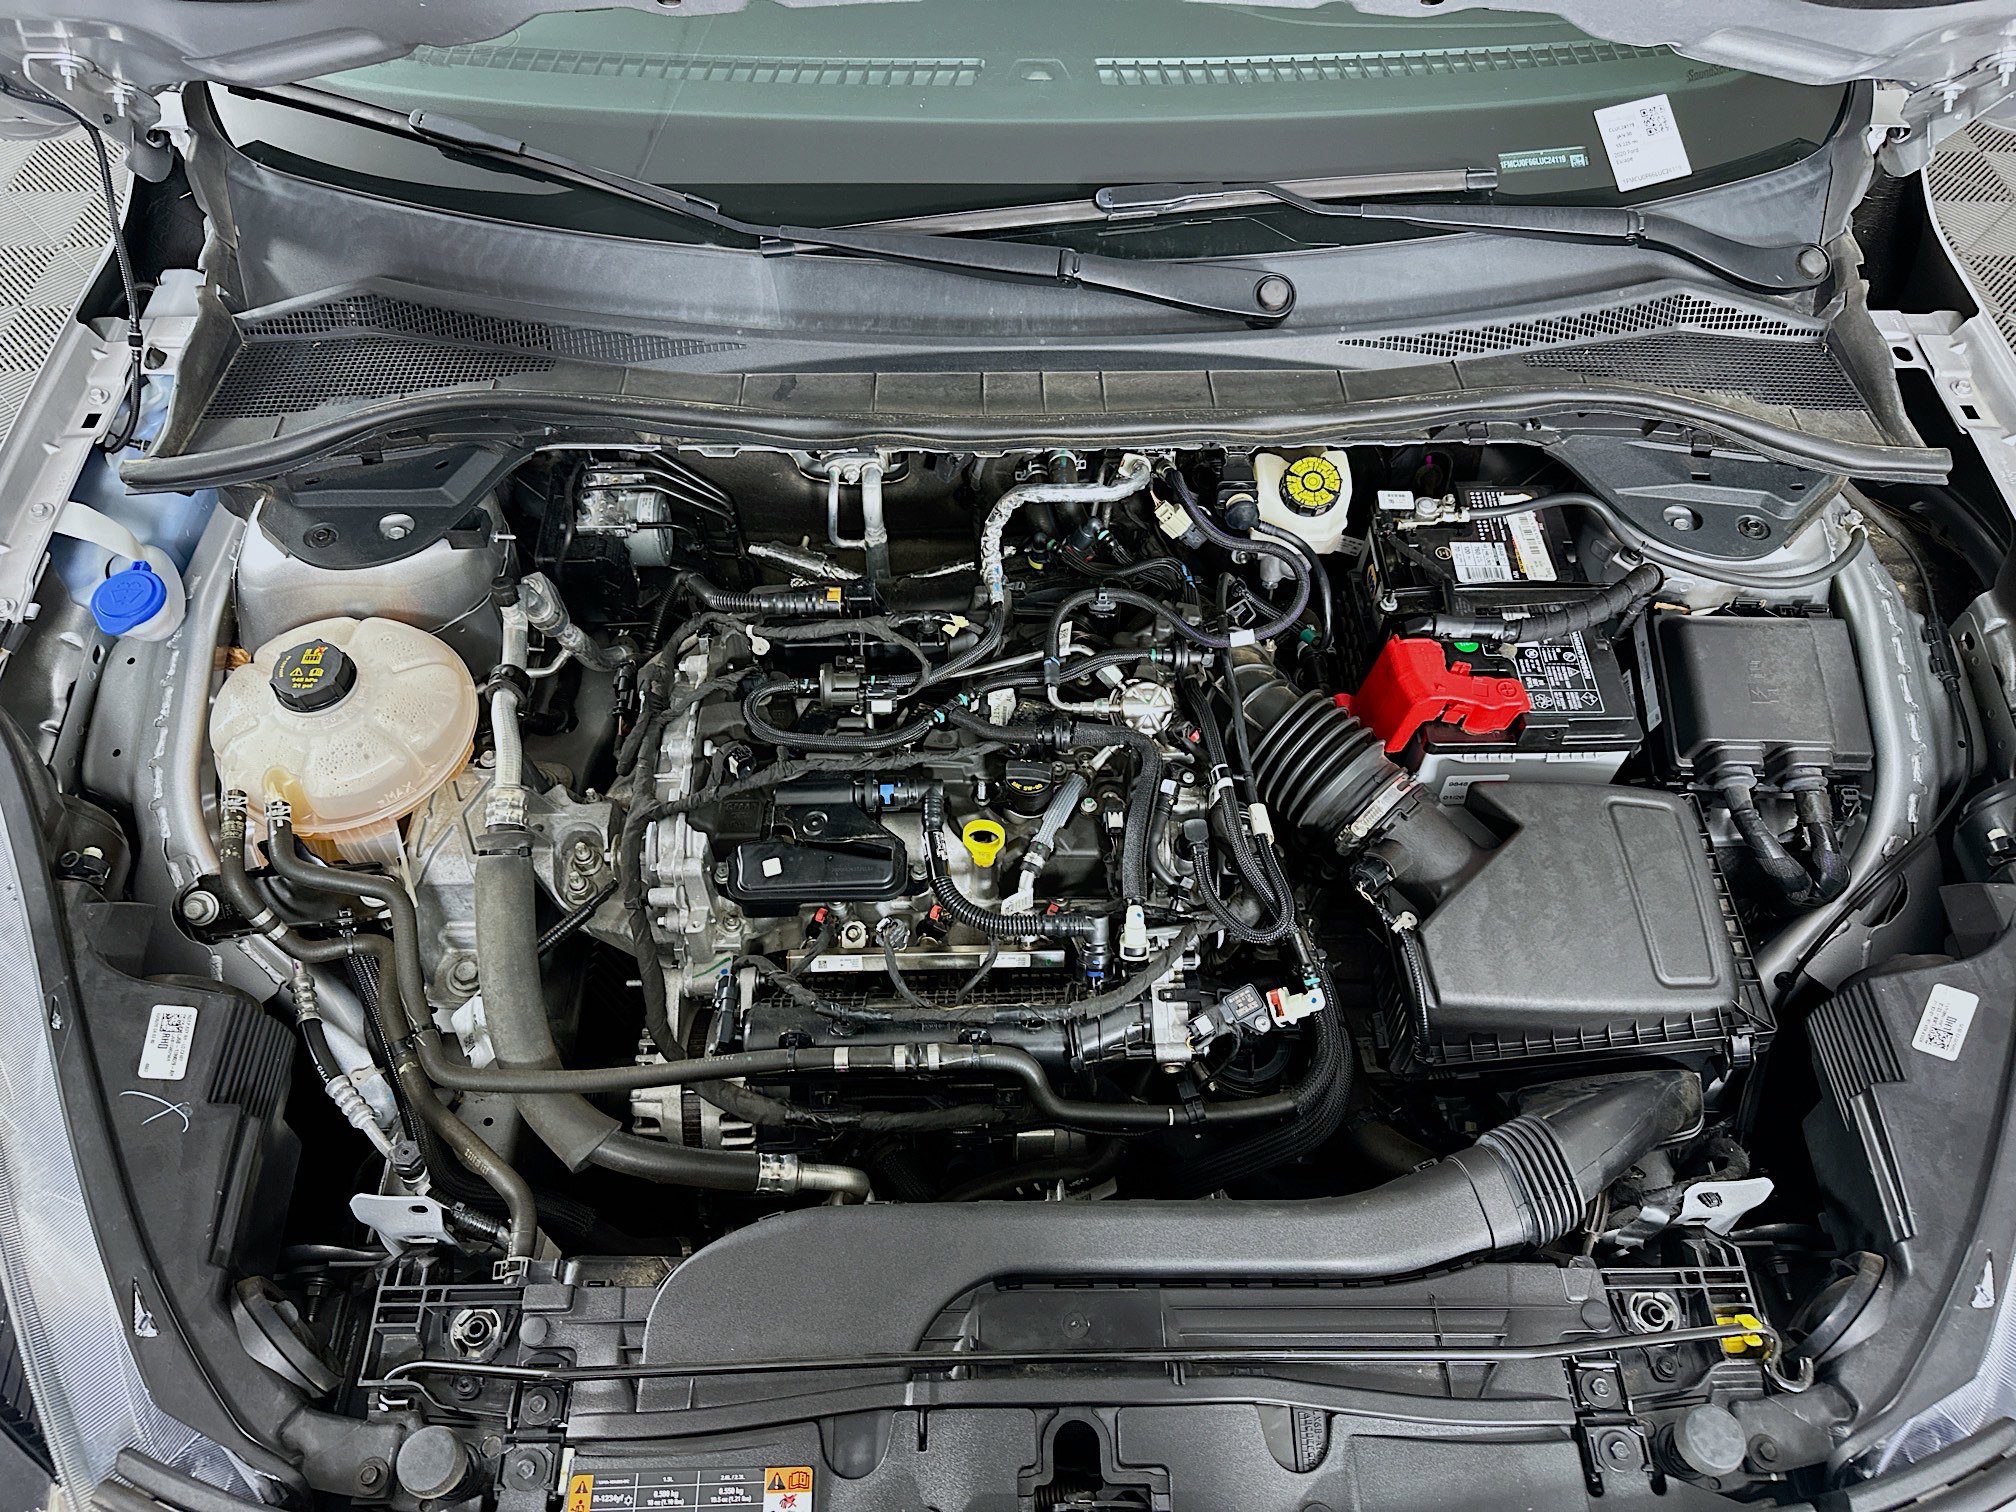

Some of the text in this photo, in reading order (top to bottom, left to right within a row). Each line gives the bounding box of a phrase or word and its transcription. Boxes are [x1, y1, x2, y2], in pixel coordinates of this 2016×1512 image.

[1572, 631, 1592, 680] ANGER/POISON
[384, 781, 416, 804] MAX
[671, 1489, 680, 1499] kg
[736, 1486, 744, 1497] kg
[592, 1493, 625, 1504] R-1234yf
